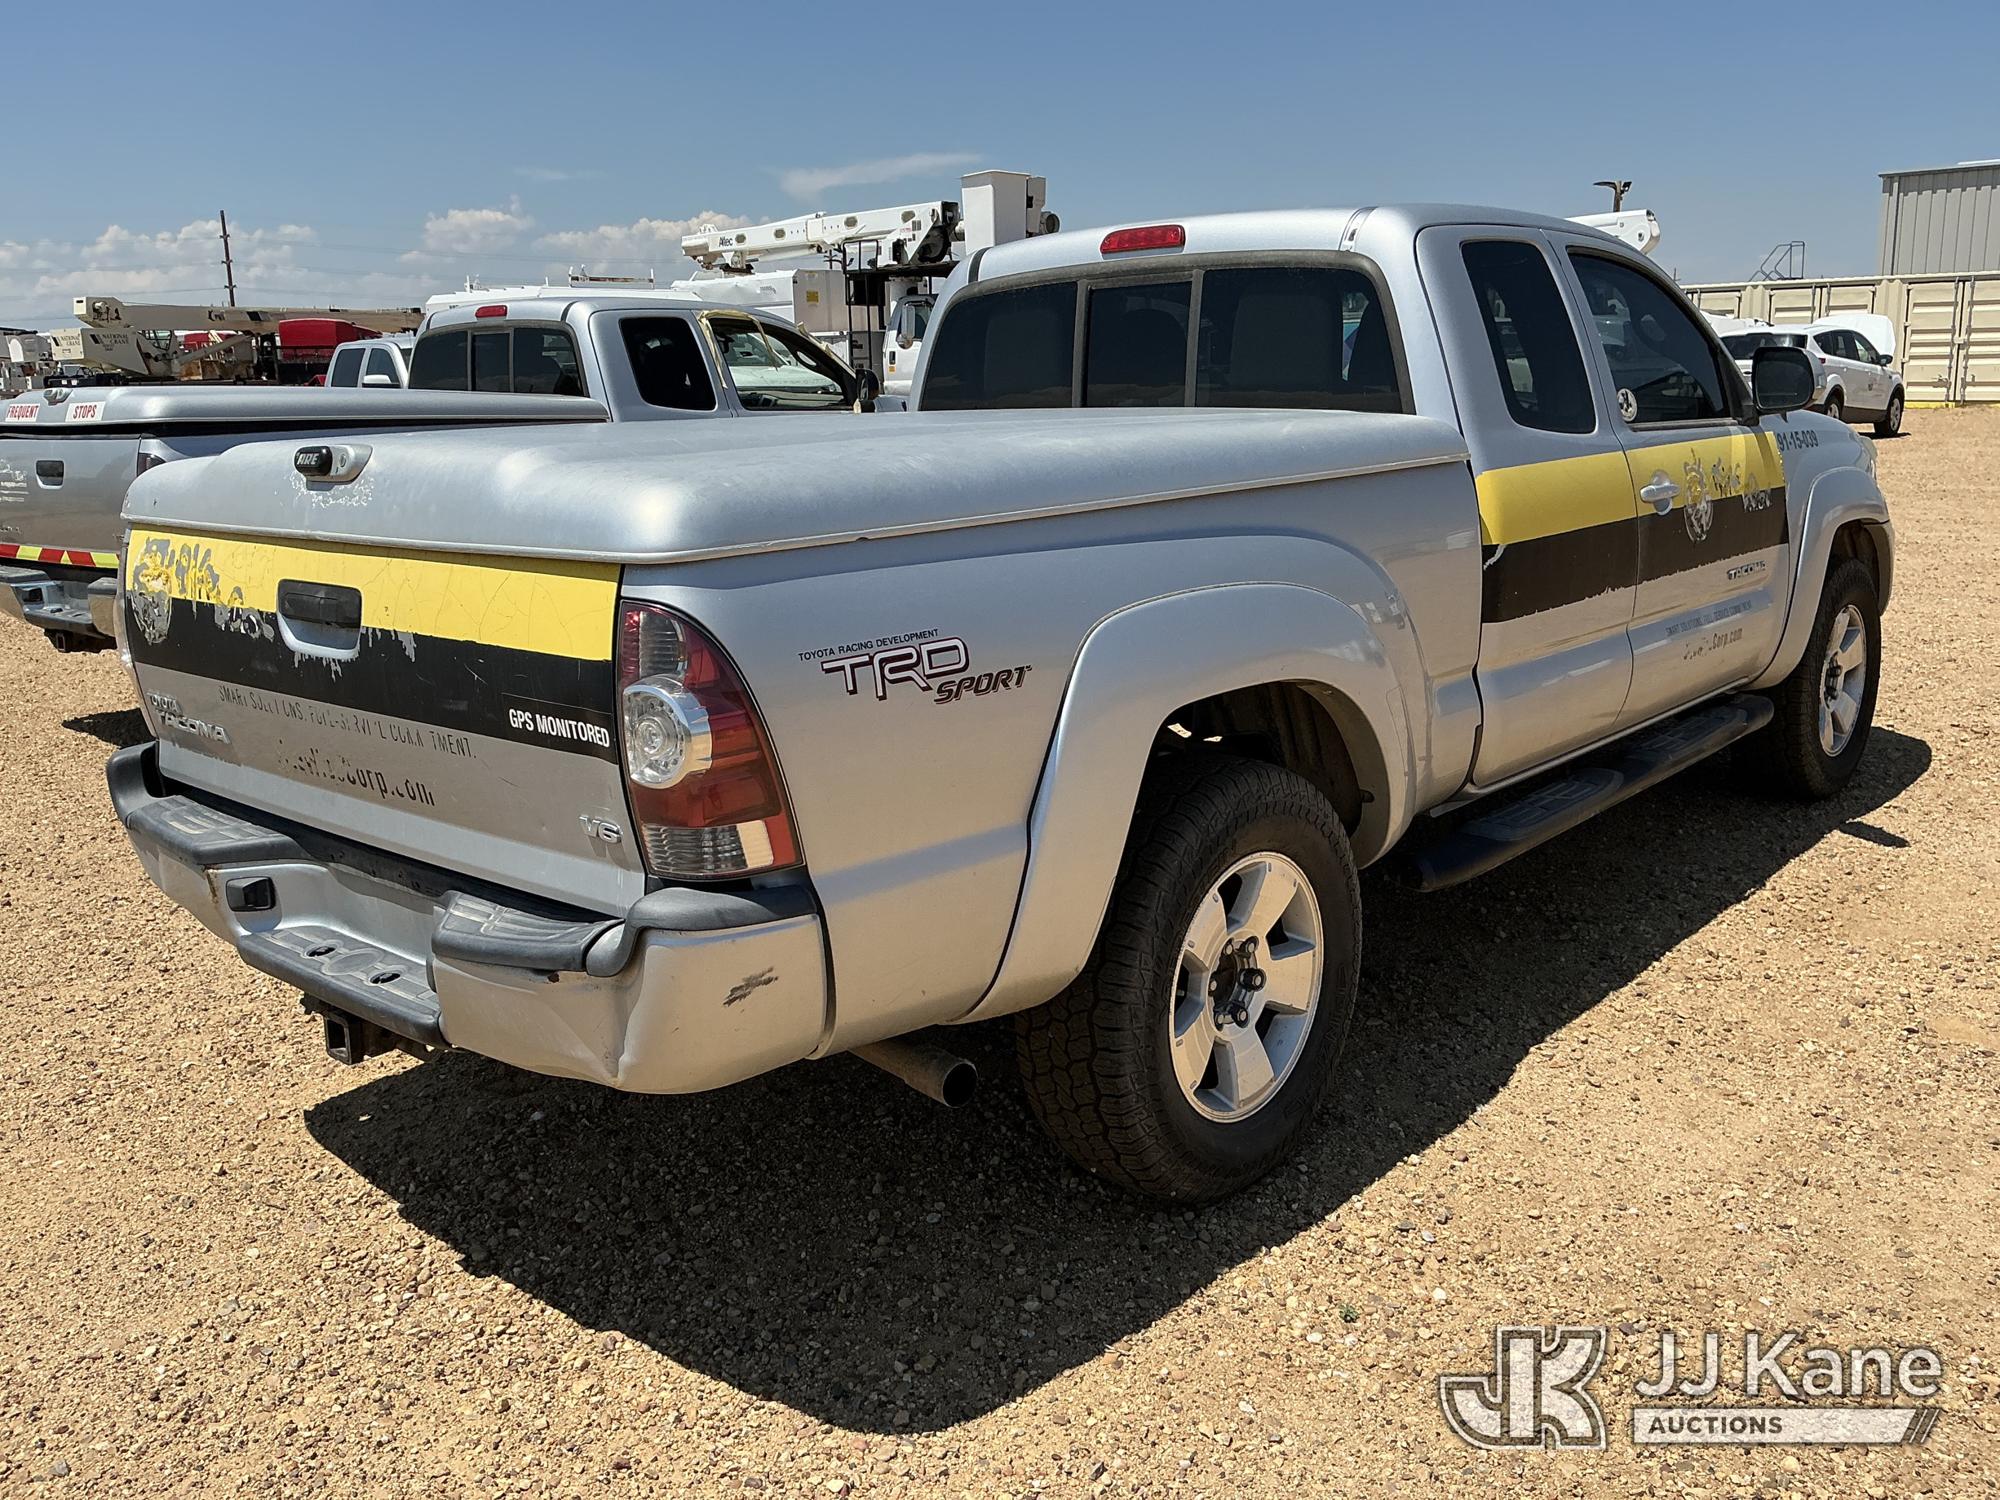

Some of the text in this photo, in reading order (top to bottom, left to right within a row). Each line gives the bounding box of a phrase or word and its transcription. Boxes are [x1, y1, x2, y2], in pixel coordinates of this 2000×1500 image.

[7, 405, 39, 420] FREQUENT
[72, 404, 98, 419] STOPS
[1777, 430, 1819, 452] 91-15-039
[798, 628, 939, 662] TOYOTA RACING DEVELOPMENT
[820, 636, 970, 701] TRD
[933, 666, 1028, 705] SPORT
[157, 708, 231, 744] TACOMA
[508, 708, 610, 748] GPS MONITORED
[579, 814, 624, 844] V6
